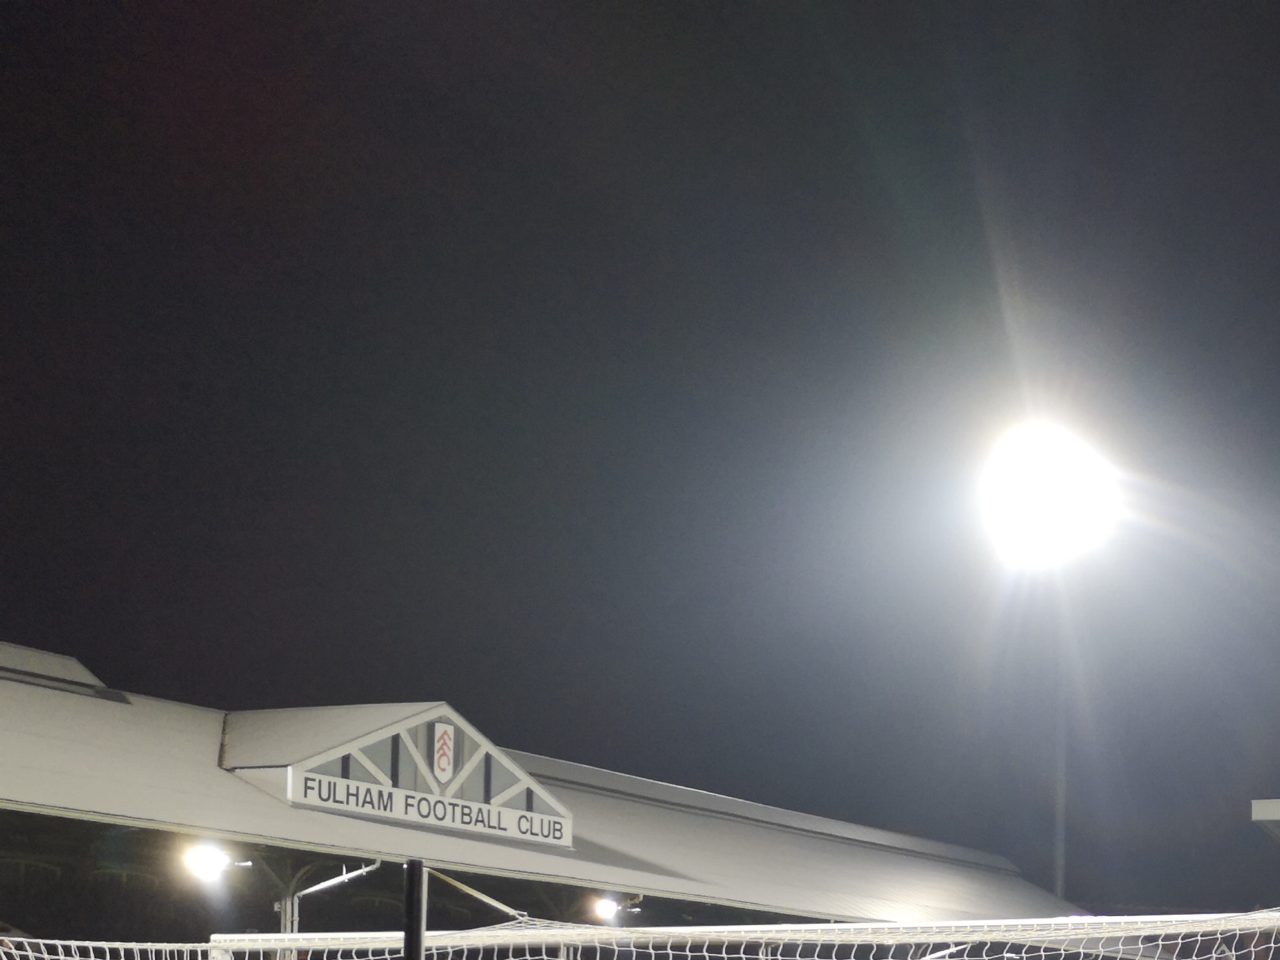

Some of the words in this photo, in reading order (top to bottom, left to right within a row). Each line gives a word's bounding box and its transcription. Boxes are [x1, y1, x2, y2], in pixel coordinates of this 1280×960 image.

[303, 777, 393, 813] FULHAM
[404, 795, 508, 832] FOOTBALL
[517, 814, 564, 841] CLUB
